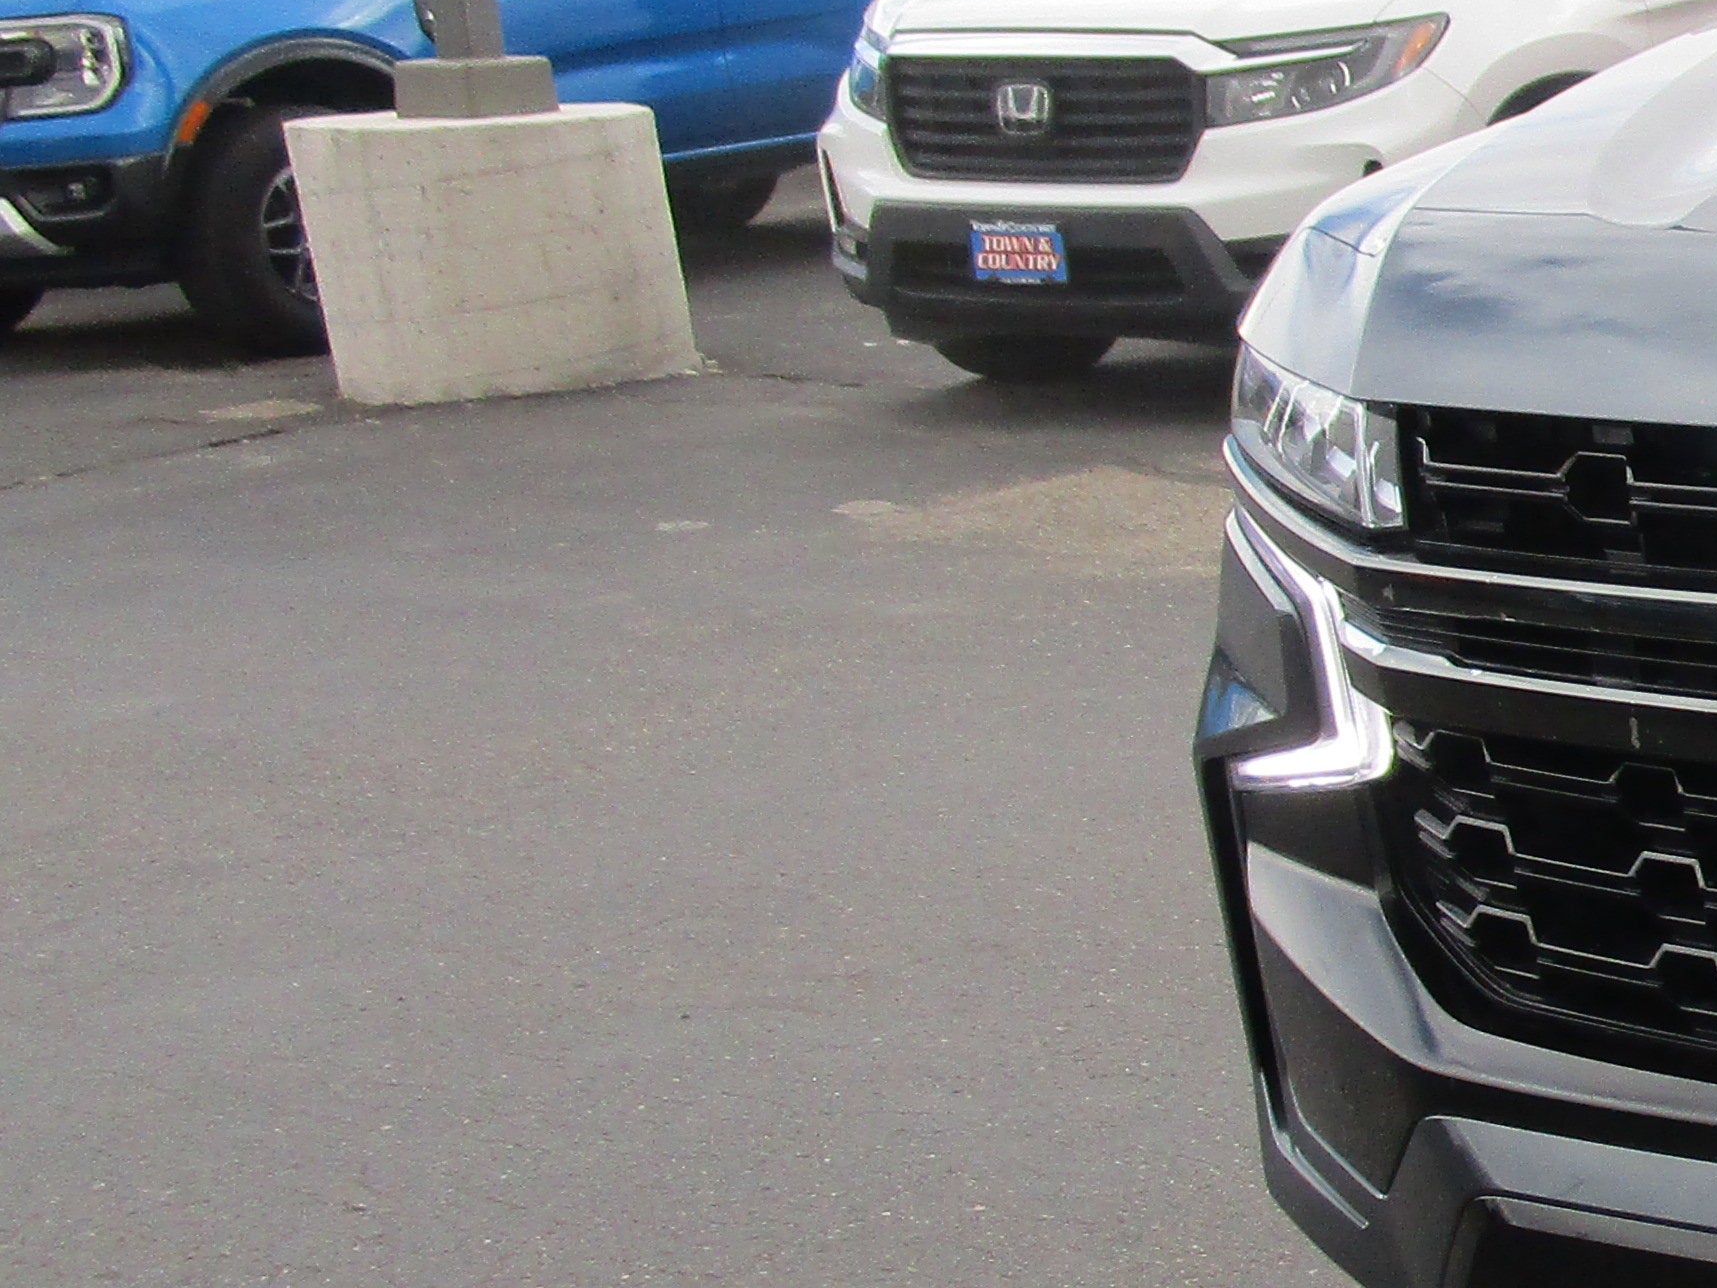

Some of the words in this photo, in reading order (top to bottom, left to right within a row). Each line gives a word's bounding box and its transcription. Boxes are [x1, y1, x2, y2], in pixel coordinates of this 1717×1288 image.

[982, 235, 1034, 253] TOWN
[1038, 236, 1053, 253] &
[977, 253, 1060, 270] COUNTRY
